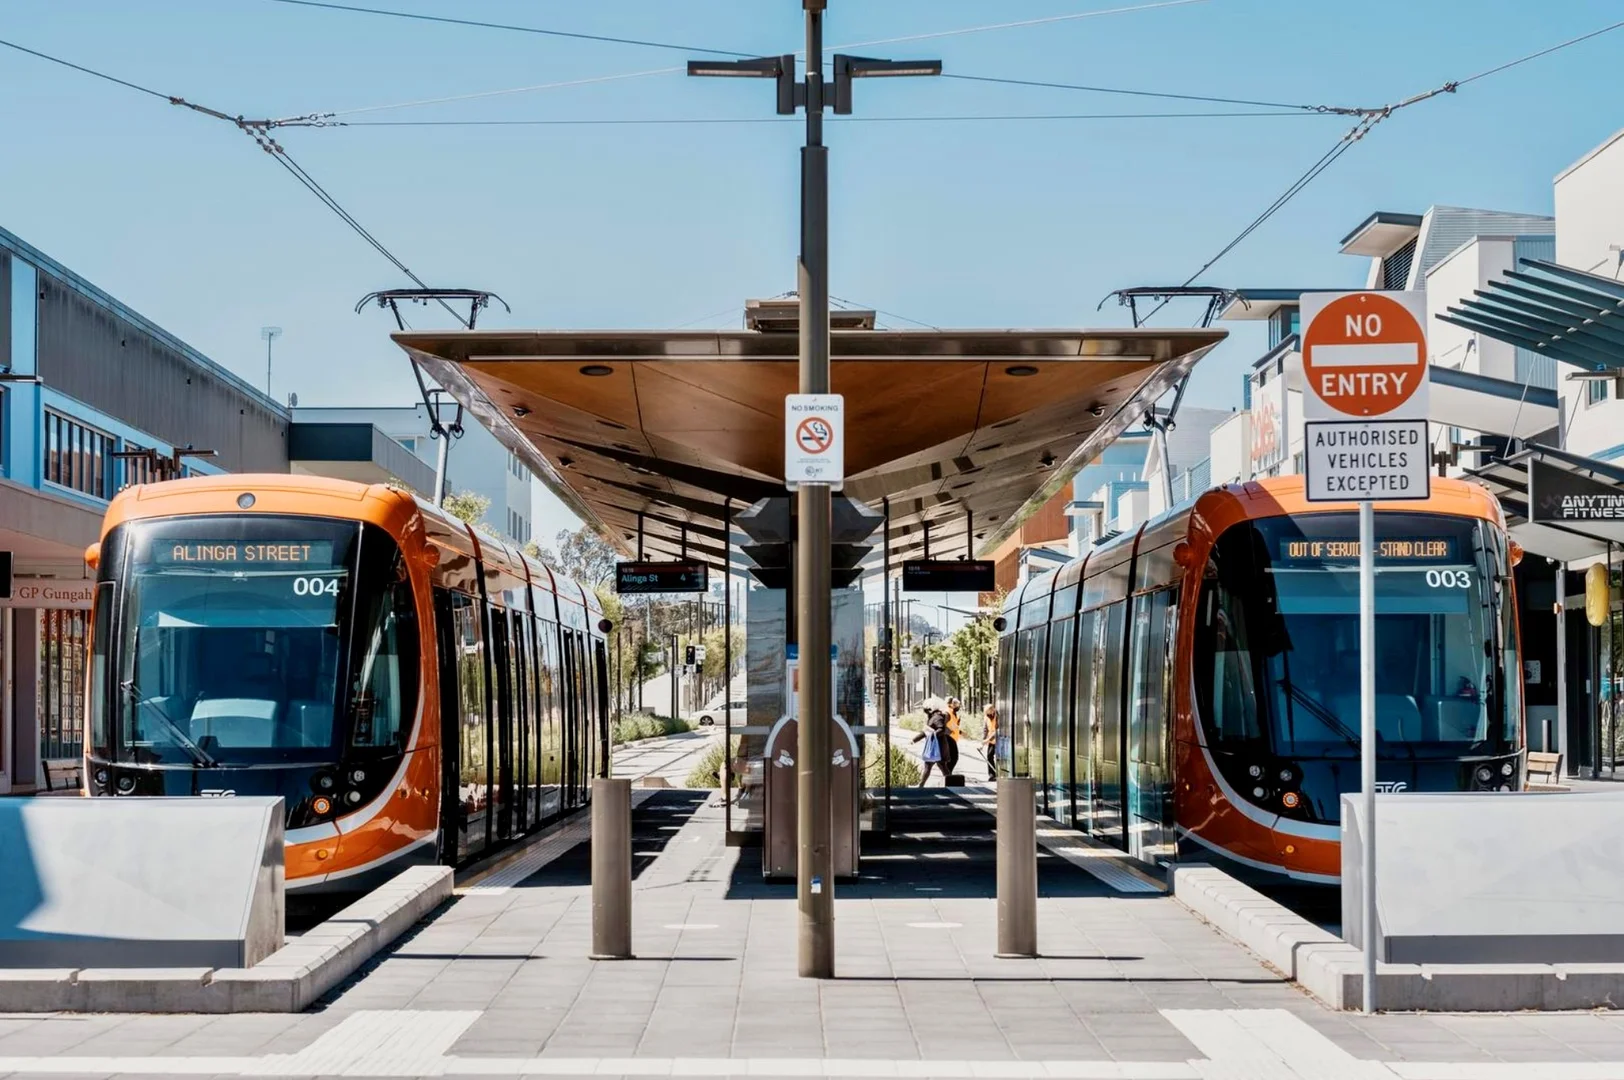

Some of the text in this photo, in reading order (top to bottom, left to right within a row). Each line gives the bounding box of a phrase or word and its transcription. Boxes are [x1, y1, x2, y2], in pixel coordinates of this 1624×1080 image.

[1345, 314, 1382, 337] NO
[1321, 372, 1408, 397] ENTRY
[1315, 429, 1419, 447] AUTHORISED
[1327, 452, 1408, 469] VEHICLES
[1327, 475, 1410, 492] EXCEPTED
[1563, 508, 1624, 518] FITNES
[173, 545, 311, 561] ALINGA STREET
[1289, 541, 1308, 557] OUT
[1311, 541, 1324, 557] OF
[1326, 541, 1361, 557] SERVIC
[1380, 541, 1412, 557] STAND
[1414, 541, 1447, 557] CLEAR
[293, 577, 340, 597] 004
[621, 574, 647, 584] Alinga
[649, 574, 658, 582] St
[1425, 570, 1472, 589] 003
[19, 587, 39, 599] GP
